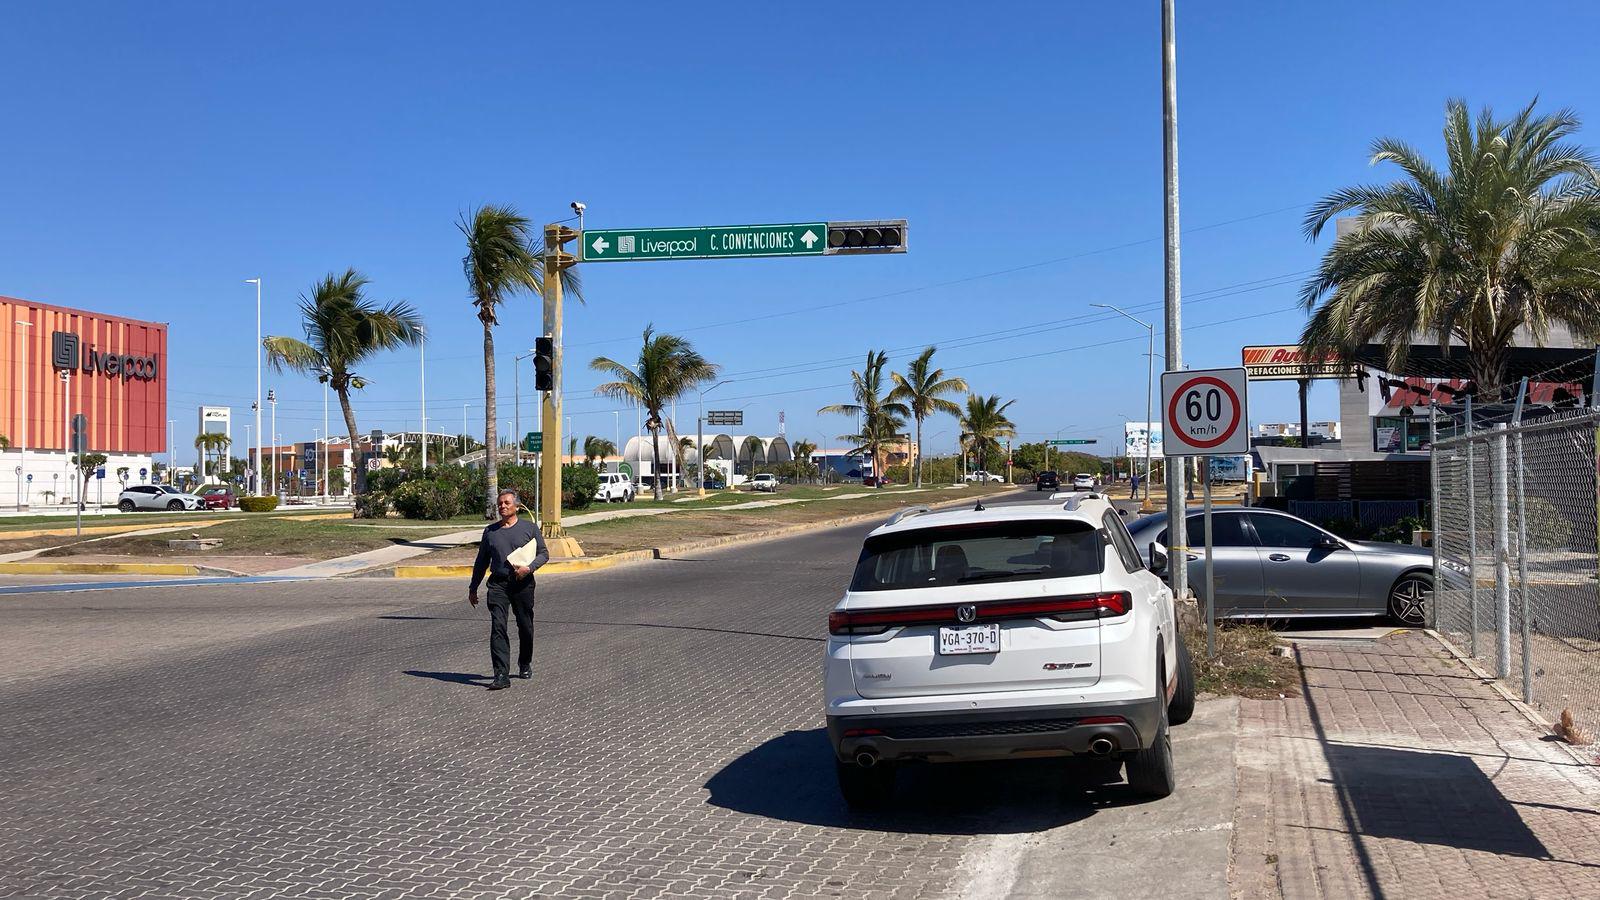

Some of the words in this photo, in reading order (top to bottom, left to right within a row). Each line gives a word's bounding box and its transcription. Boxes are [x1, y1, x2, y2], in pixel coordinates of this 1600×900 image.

[641, 237, 697, 255] Liverpool
[710, 234, 719, 251] C.
[722, 231, 794, 250] CONVENCIONES
[82, 342, 158, 384] Liverpool
[1248, 366, 1301, 376] REFACCIONES
[1185, 388, 1222, 422] 60
[1190, 424, 1218, 435] km/h
[941, 631, 997, 646] VGA-370-D
